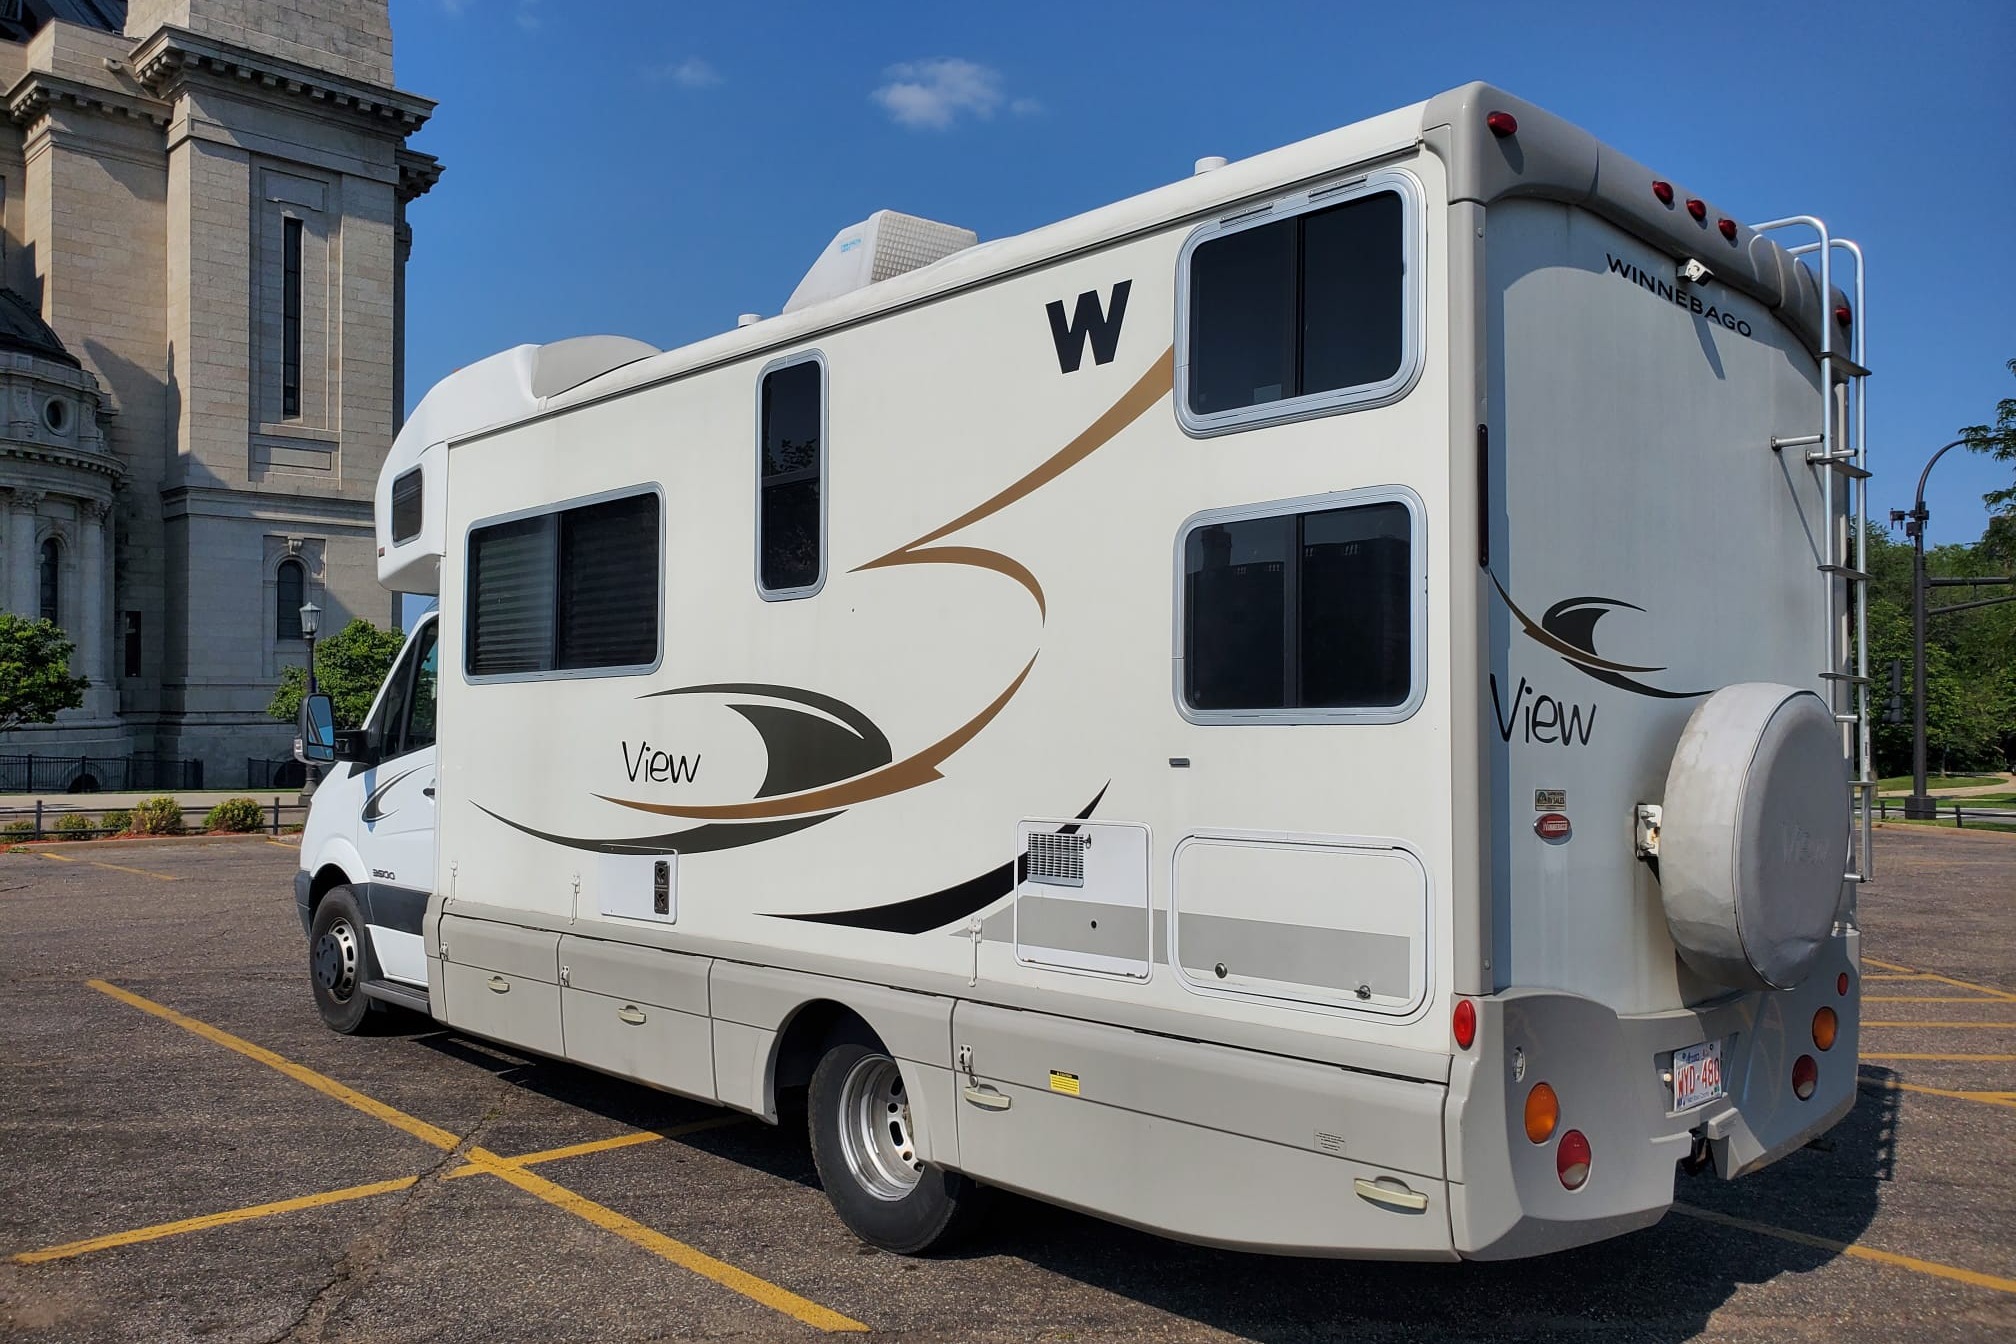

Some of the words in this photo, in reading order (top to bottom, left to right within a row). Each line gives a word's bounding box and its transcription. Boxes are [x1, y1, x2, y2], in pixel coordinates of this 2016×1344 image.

[1045, 278, 1133, 375] W
[1606, 253, 1752, 337] WINNEBAGO
[1489, 672, 1597, 747] View
[621, 740, 702, 784] View
[372, 868, 396, 880] 3500
